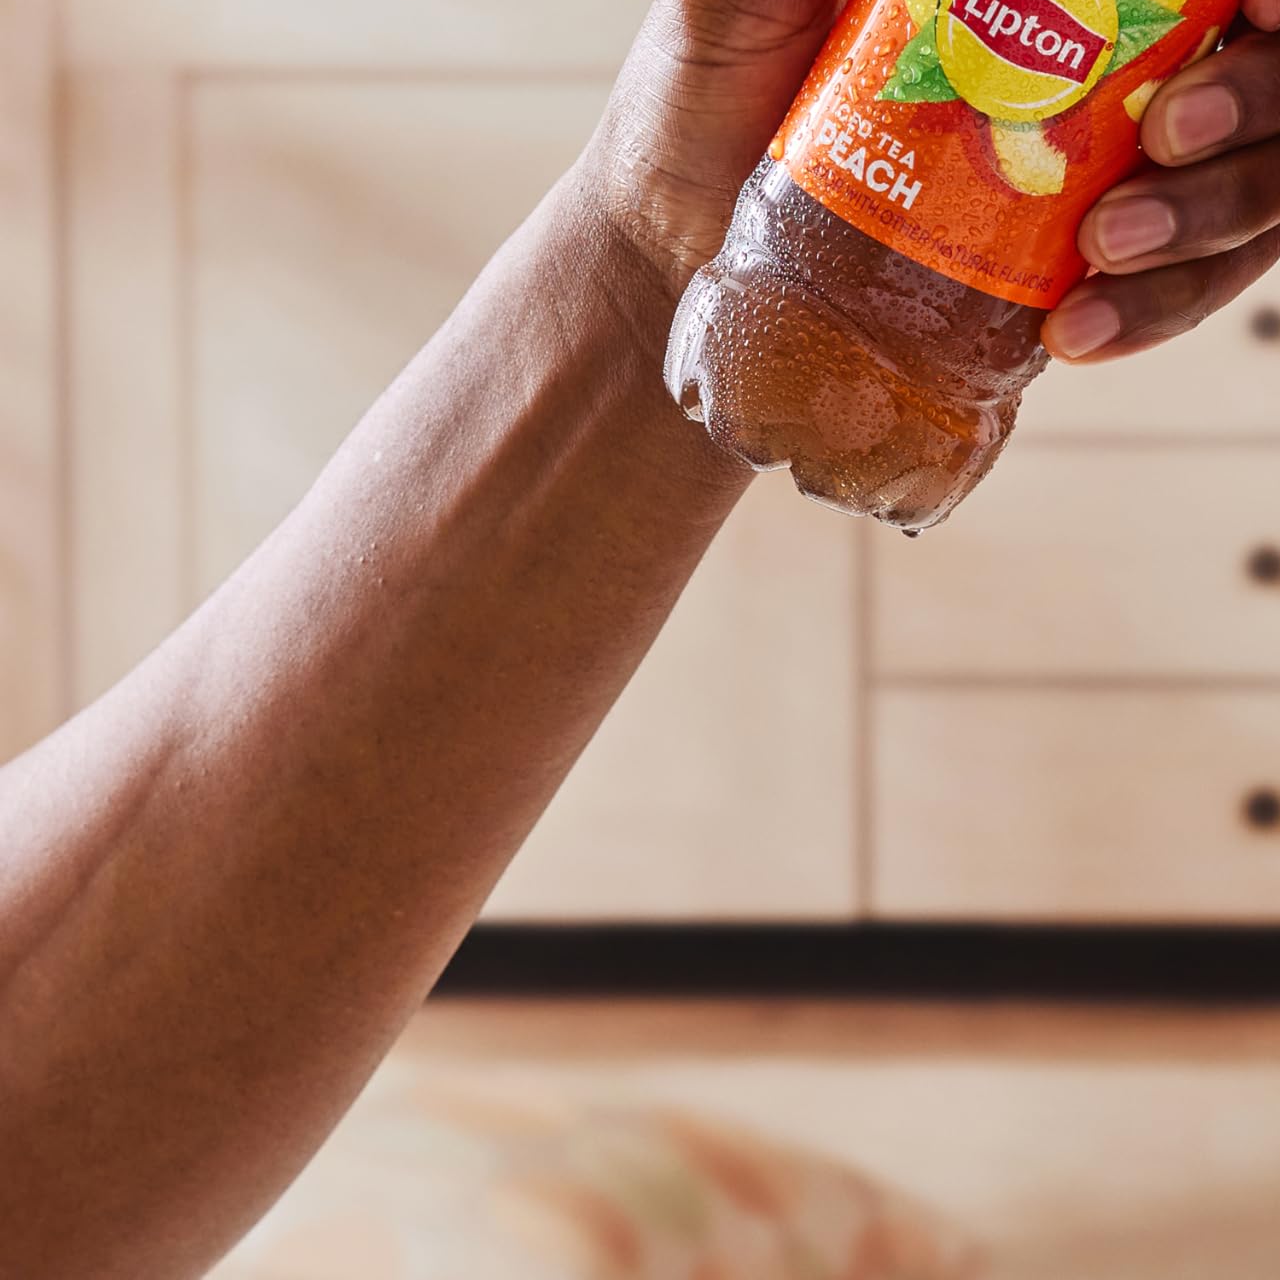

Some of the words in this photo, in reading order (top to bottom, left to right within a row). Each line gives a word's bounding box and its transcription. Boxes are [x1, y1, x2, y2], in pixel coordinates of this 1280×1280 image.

[815, 119, 923, 210] PEACH
[877, 132, 915, 170] TEA
[845, 184, 881, 216] WITH
[880, 209, 931, 244] OTHER
[932, 237, 998, 277] NATURAL
[998, 265, 1054, 293] FLAVORS
